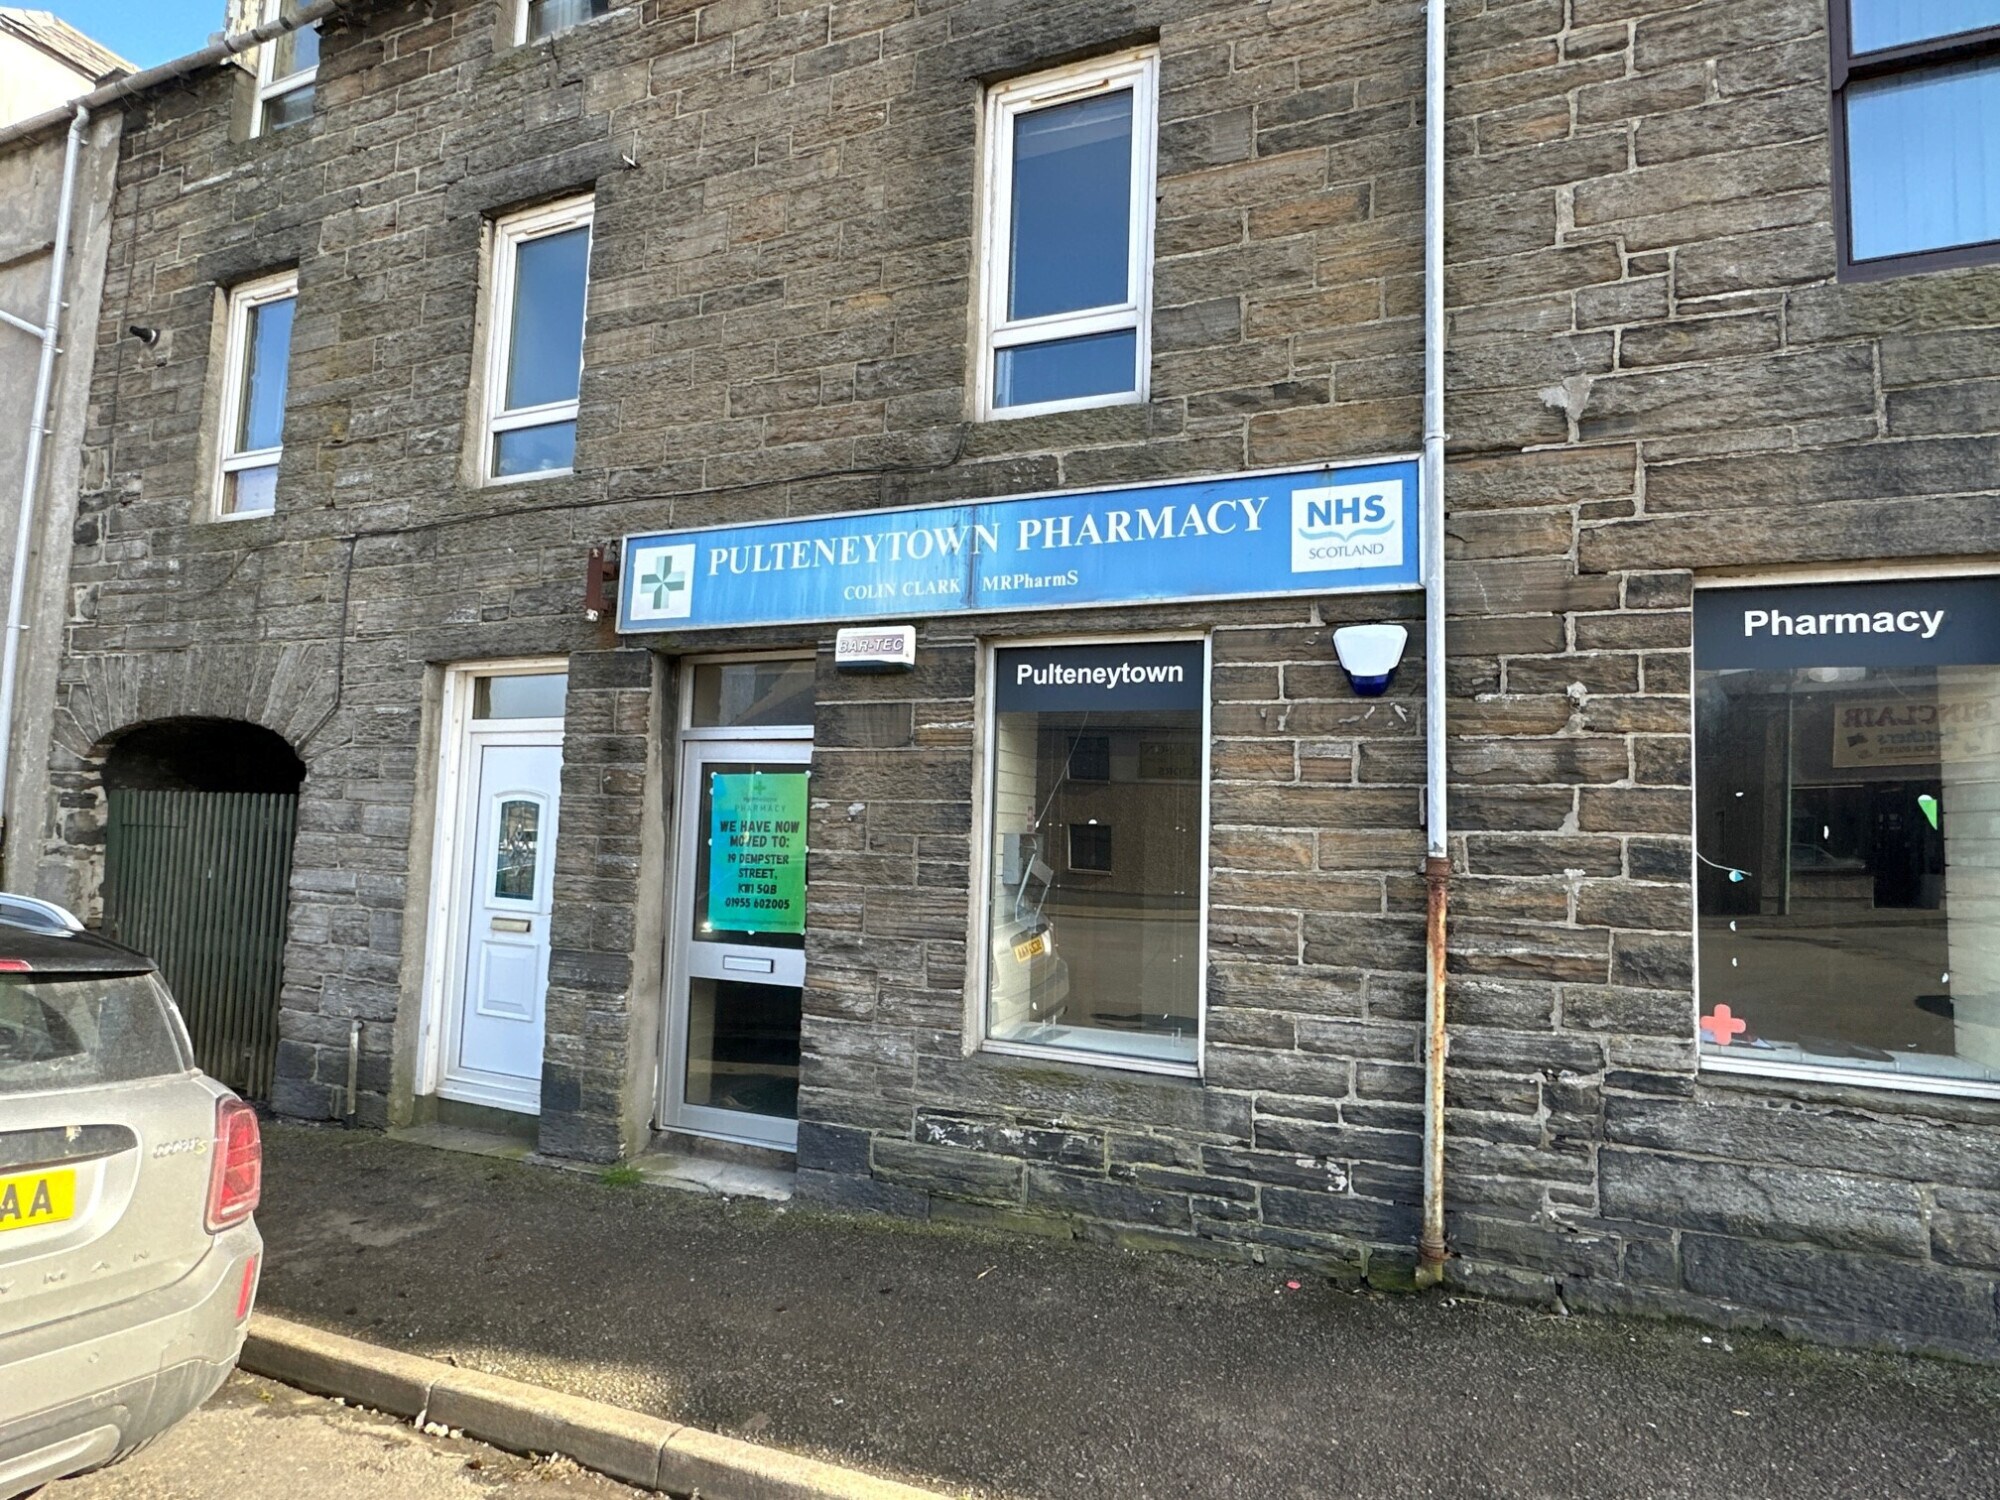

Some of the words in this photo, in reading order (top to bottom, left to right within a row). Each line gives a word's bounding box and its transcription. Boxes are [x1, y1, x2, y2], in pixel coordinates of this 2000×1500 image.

[1307, 494, 1386, 528] NHS
[707, 521, 1000, 576] PULTENEYTOWN
[1016, 496, 1270, 552] PHARMACY
[1308, 543, 1384, 560] SCOTLAND
[843, 583, 896, 601] COLIN
[902, 577, 961, 597] CLARK
[982, 570, 1079, 592] MRPharmS
[1744, 609, 1945, 639] Pharmacy
[838, 638, 904, 654] BAR-TEC
[1016, 662, 1184, 690] Pulteneytown
[720, 821, 737, 832] WE
[740, 821, 771, 833] HAVE
[775, 821, 800, 833] NOW
[730, 836, 767, 847] MOVED
[772, 836, 790, 848] TO:
[728, 854, 737, 864] 19
[739, 854, 789, 865] DEMPSTER
[738, 868, 778, 880] STREET,
